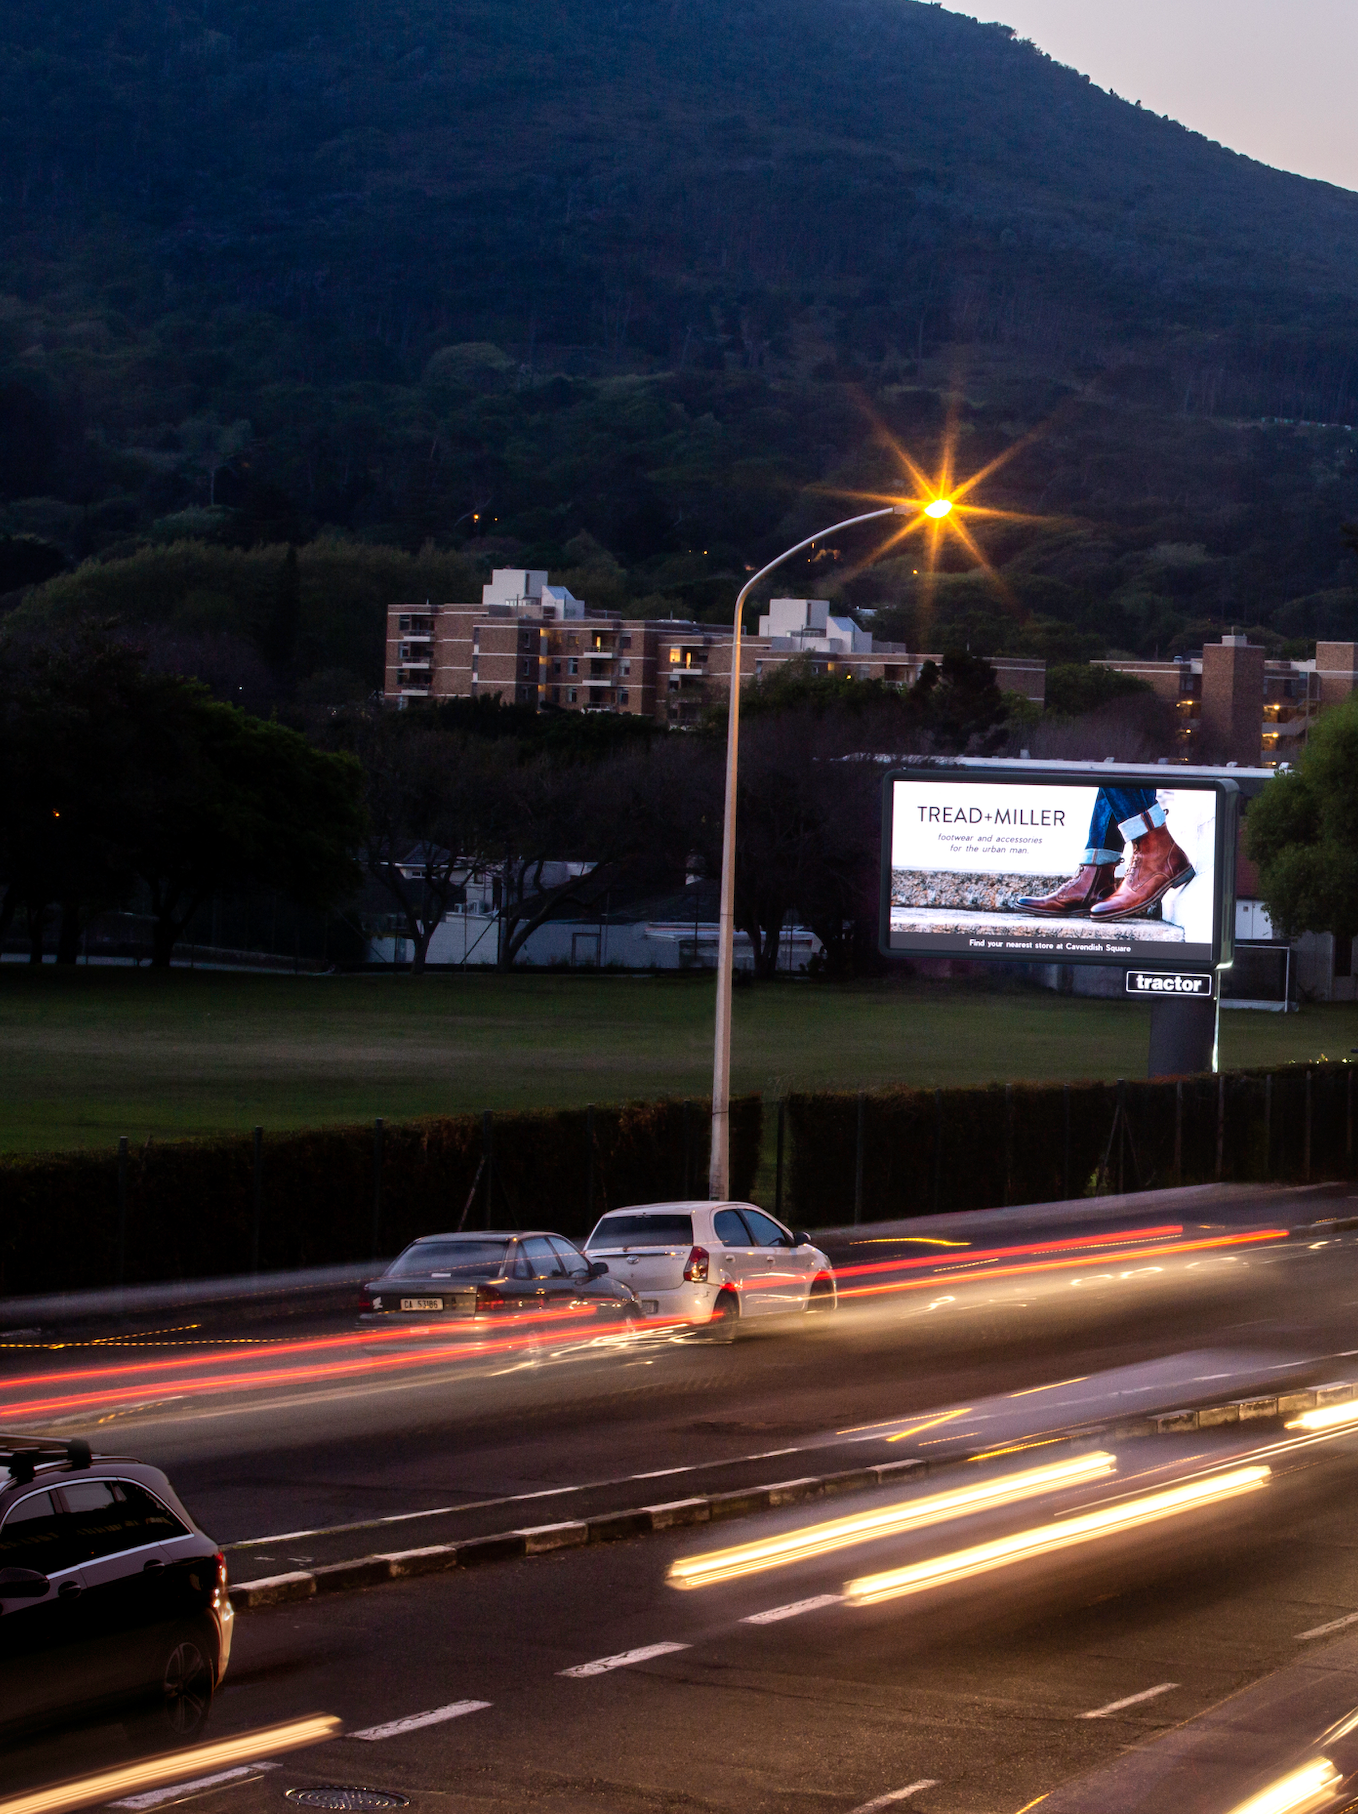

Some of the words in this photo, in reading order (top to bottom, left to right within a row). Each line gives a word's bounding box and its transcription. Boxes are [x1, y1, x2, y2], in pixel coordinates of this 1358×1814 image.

[917, 805, 1066, 827] TREAD+MILLER
[937, 832, 974, 843] footwear
[977, 834, 993, 844] and
[995, 835, 1043, 845] accessories
[949, 843, 962, 853] for
[965, 844, 979, 853] the
[982, 845, 1006, 854] urban
[1009, 846, 1029, 855] man.
[969, 938, 986, 947] Find
[987, 941, 1004, 950] your
[1005, 941, 1033, 949] nearest
[1034, 942, 1054, 950] store
[1065, 942, 1103, 952] Cavendish
[1105, 943, 1132, 954] Square
[1136, 974, 1202, 992] tractor
[404, 1300, 413, 1309] CA
